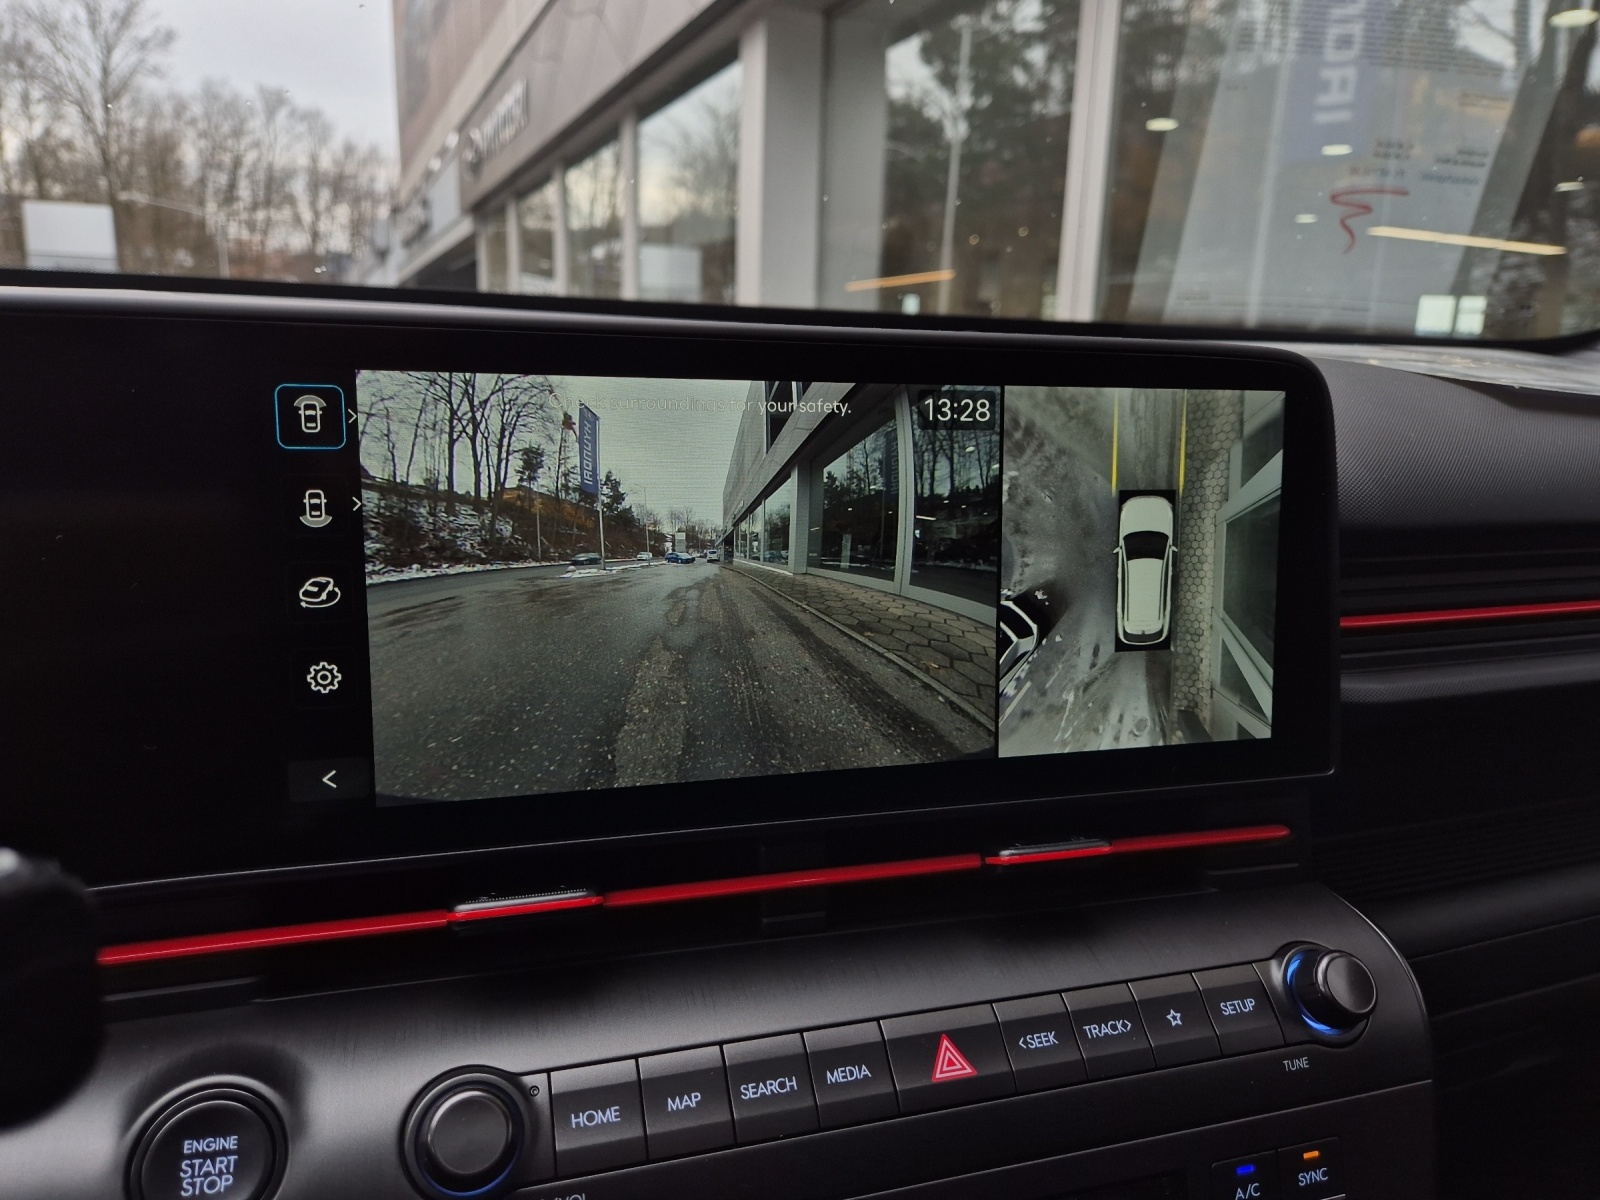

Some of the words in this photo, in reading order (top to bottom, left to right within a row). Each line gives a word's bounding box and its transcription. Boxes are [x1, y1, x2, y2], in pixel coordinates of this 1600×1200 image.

[610, 394, 725, 415] surroundings
[728, 397, 753, 412] for
[758, 399, 797, 415] your
[799, 398, 852, 417] safety.
[924, 398, 991, 422] 13:28
[1219, 998, 1256, 1016] SETUP
[826, 1064, 872, 1085] MEDIA
[1282, 1056, 1310, 1072] TUNE
[740, 1075, 798, 1100] SEARCH
[667, 1092, 702, 1112] MAP
[571, 1105, 621, 1129] HOME
[183, 1135, 239, 1154] ENGINE
[179, 1155, 239, 1178] START
[1298, 1167, 1329, 1187] SYNC
[180, 1175, 234, 1197] STOP
[1235, 1182, 1261, 1200] A/C
